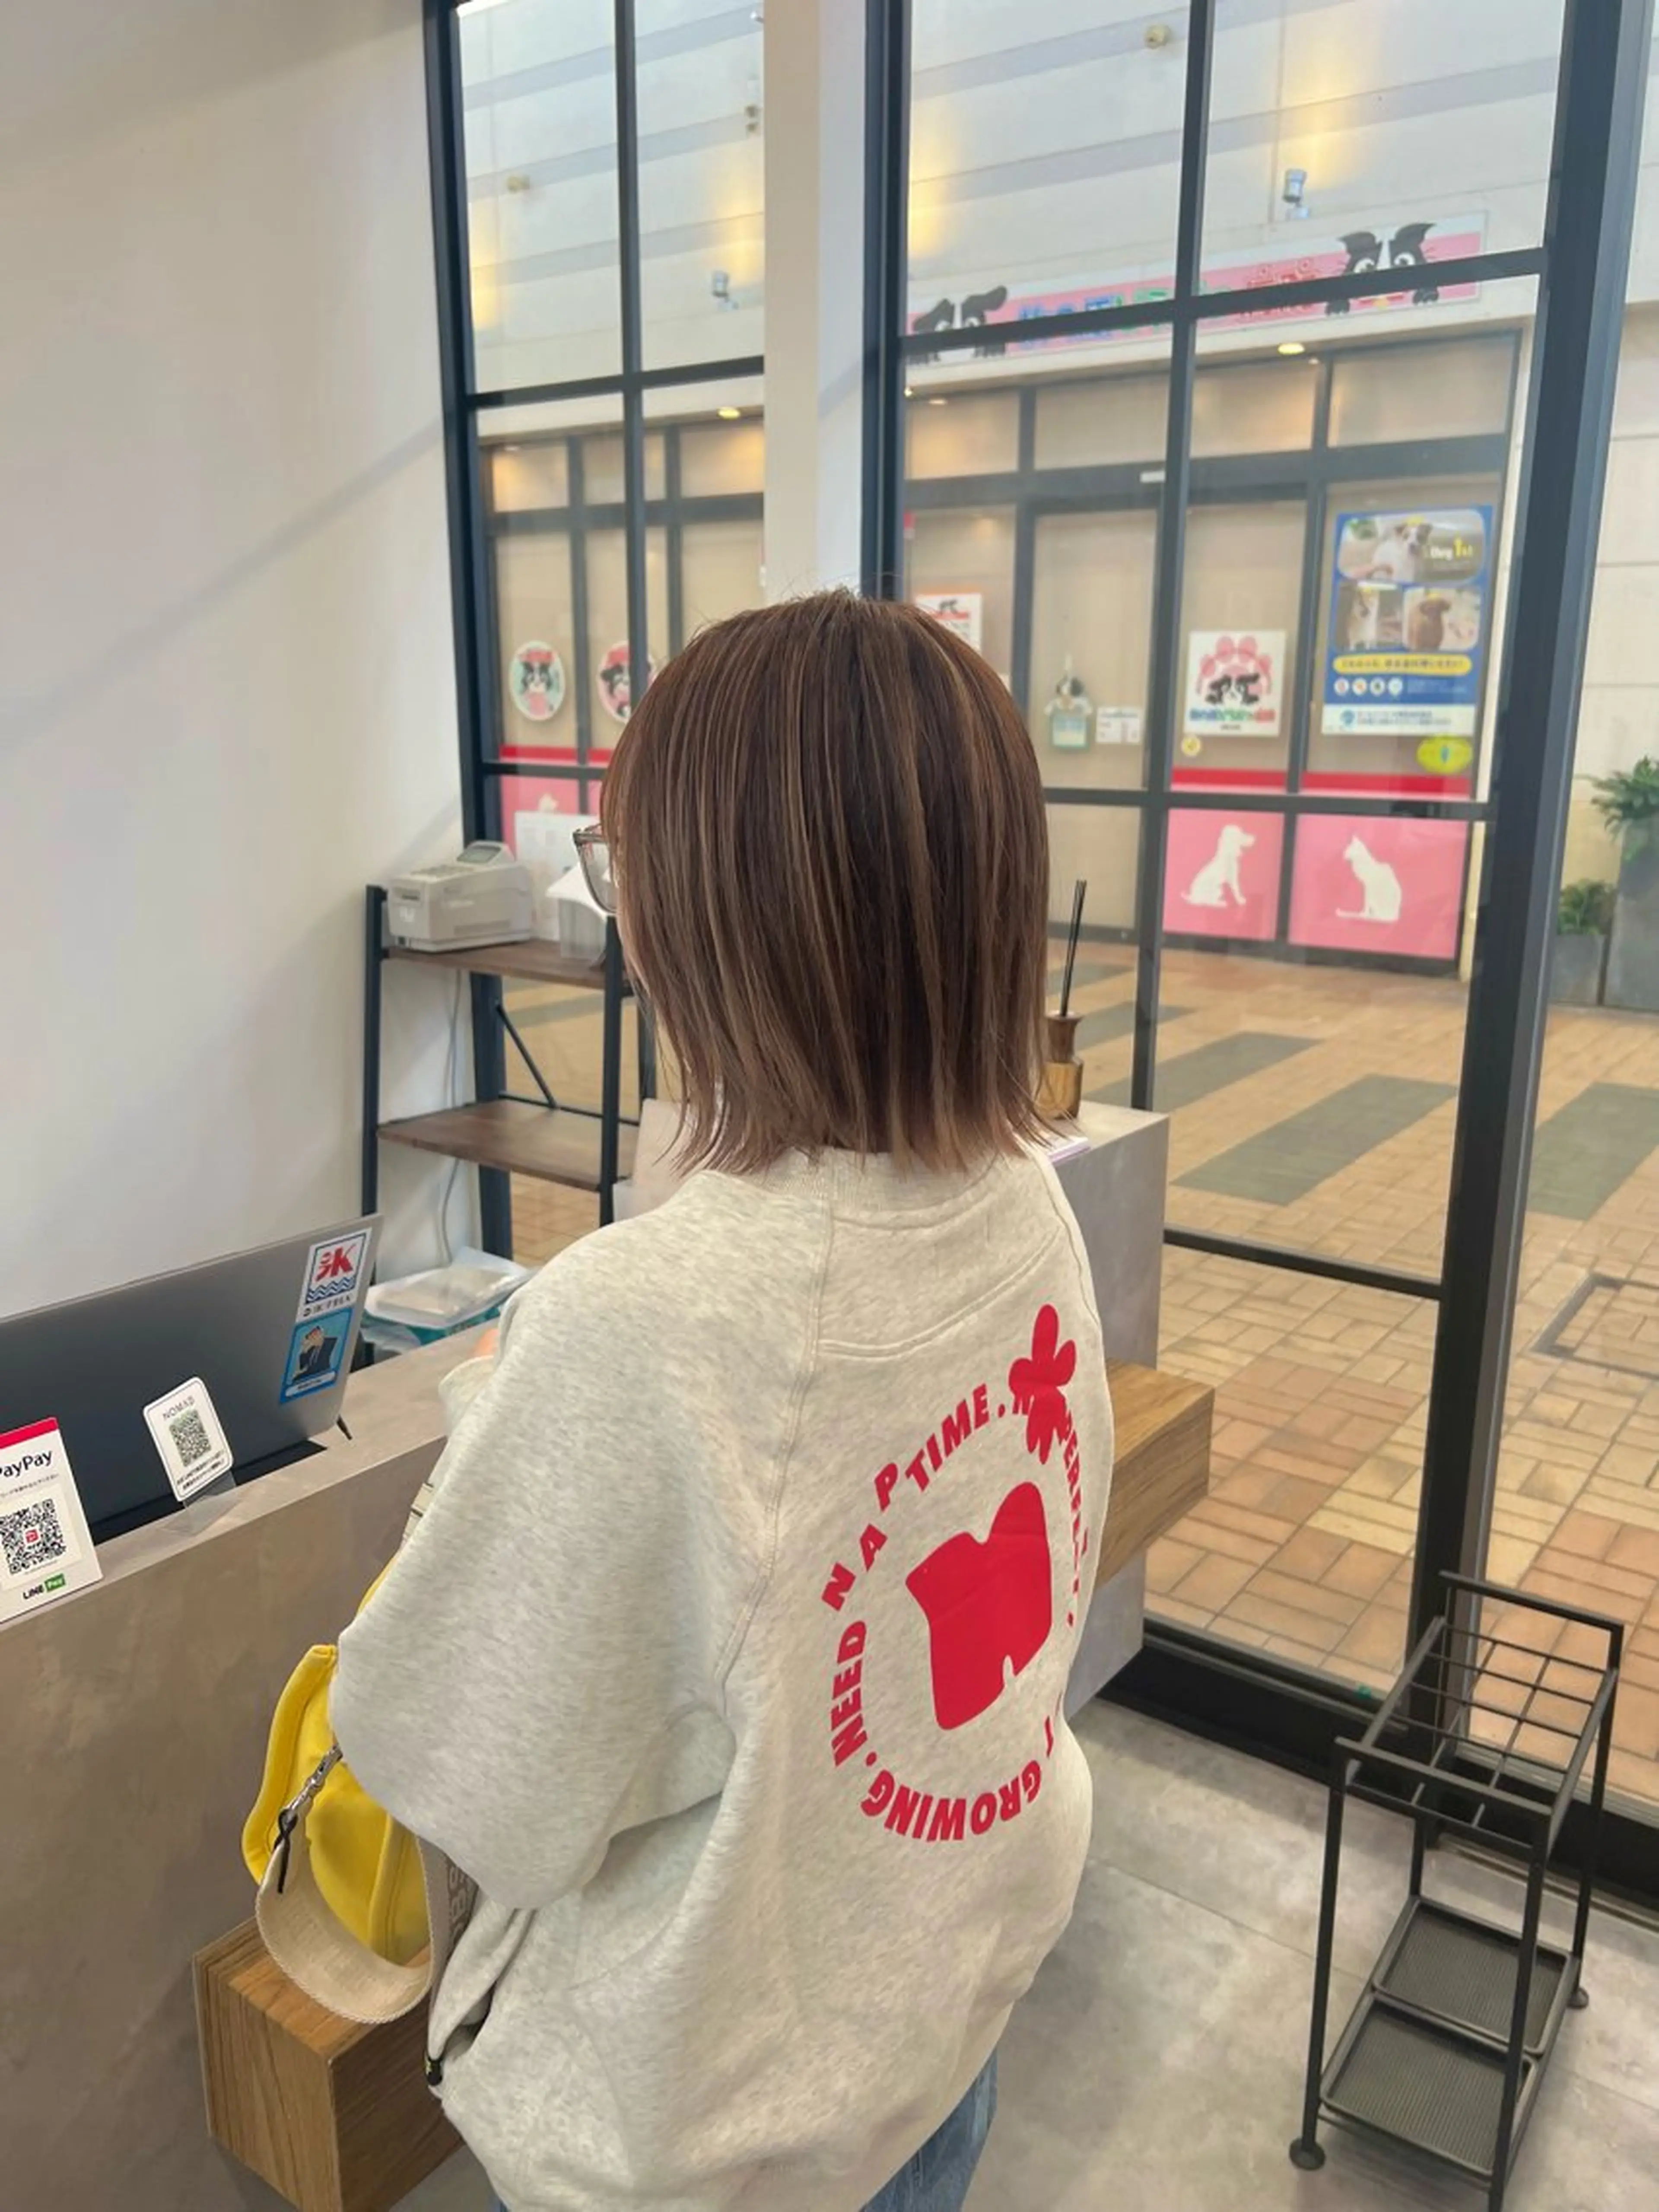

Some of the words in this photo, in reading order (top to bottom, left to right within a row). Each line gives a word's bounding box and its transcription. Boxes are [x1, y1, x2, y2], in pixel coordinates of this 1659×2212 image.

[0, 1450, 52, 1478] ayPay
[23, 1584, 44, 1599] LINE
[831, 1621, 867, 1766] NEED
[861, 1752, 1042, 1841] GROWING.
